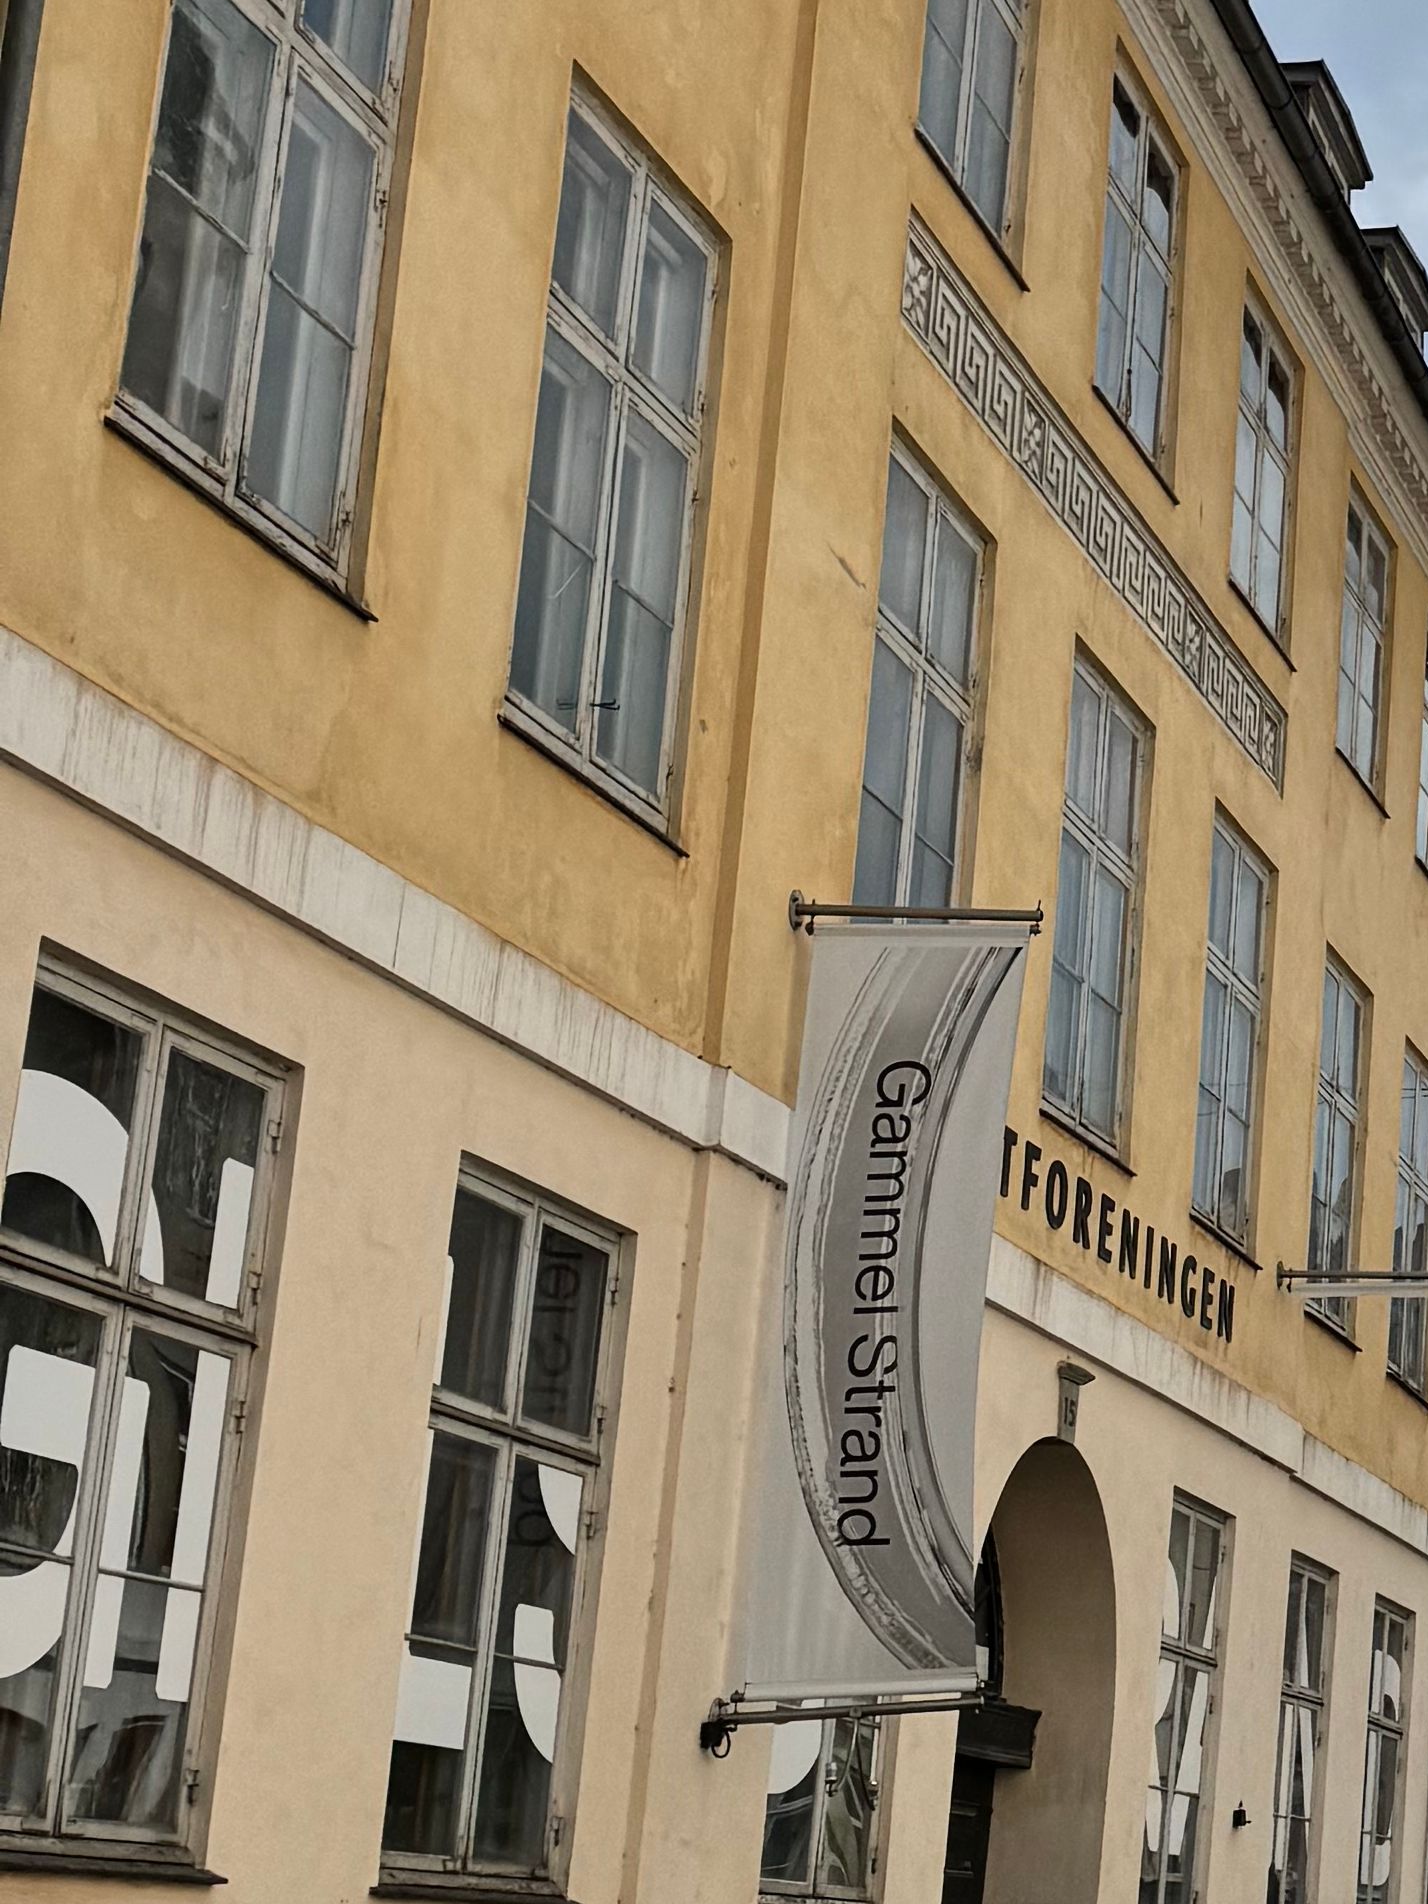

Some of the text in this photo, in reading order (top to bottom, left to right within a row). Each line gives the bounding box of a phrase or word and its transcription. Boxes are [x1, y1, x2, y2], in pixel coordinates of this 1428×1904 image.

[836, 1060, 932, 1546] Gammel Strand
[1064, 1396, 1078, 1427] 15
